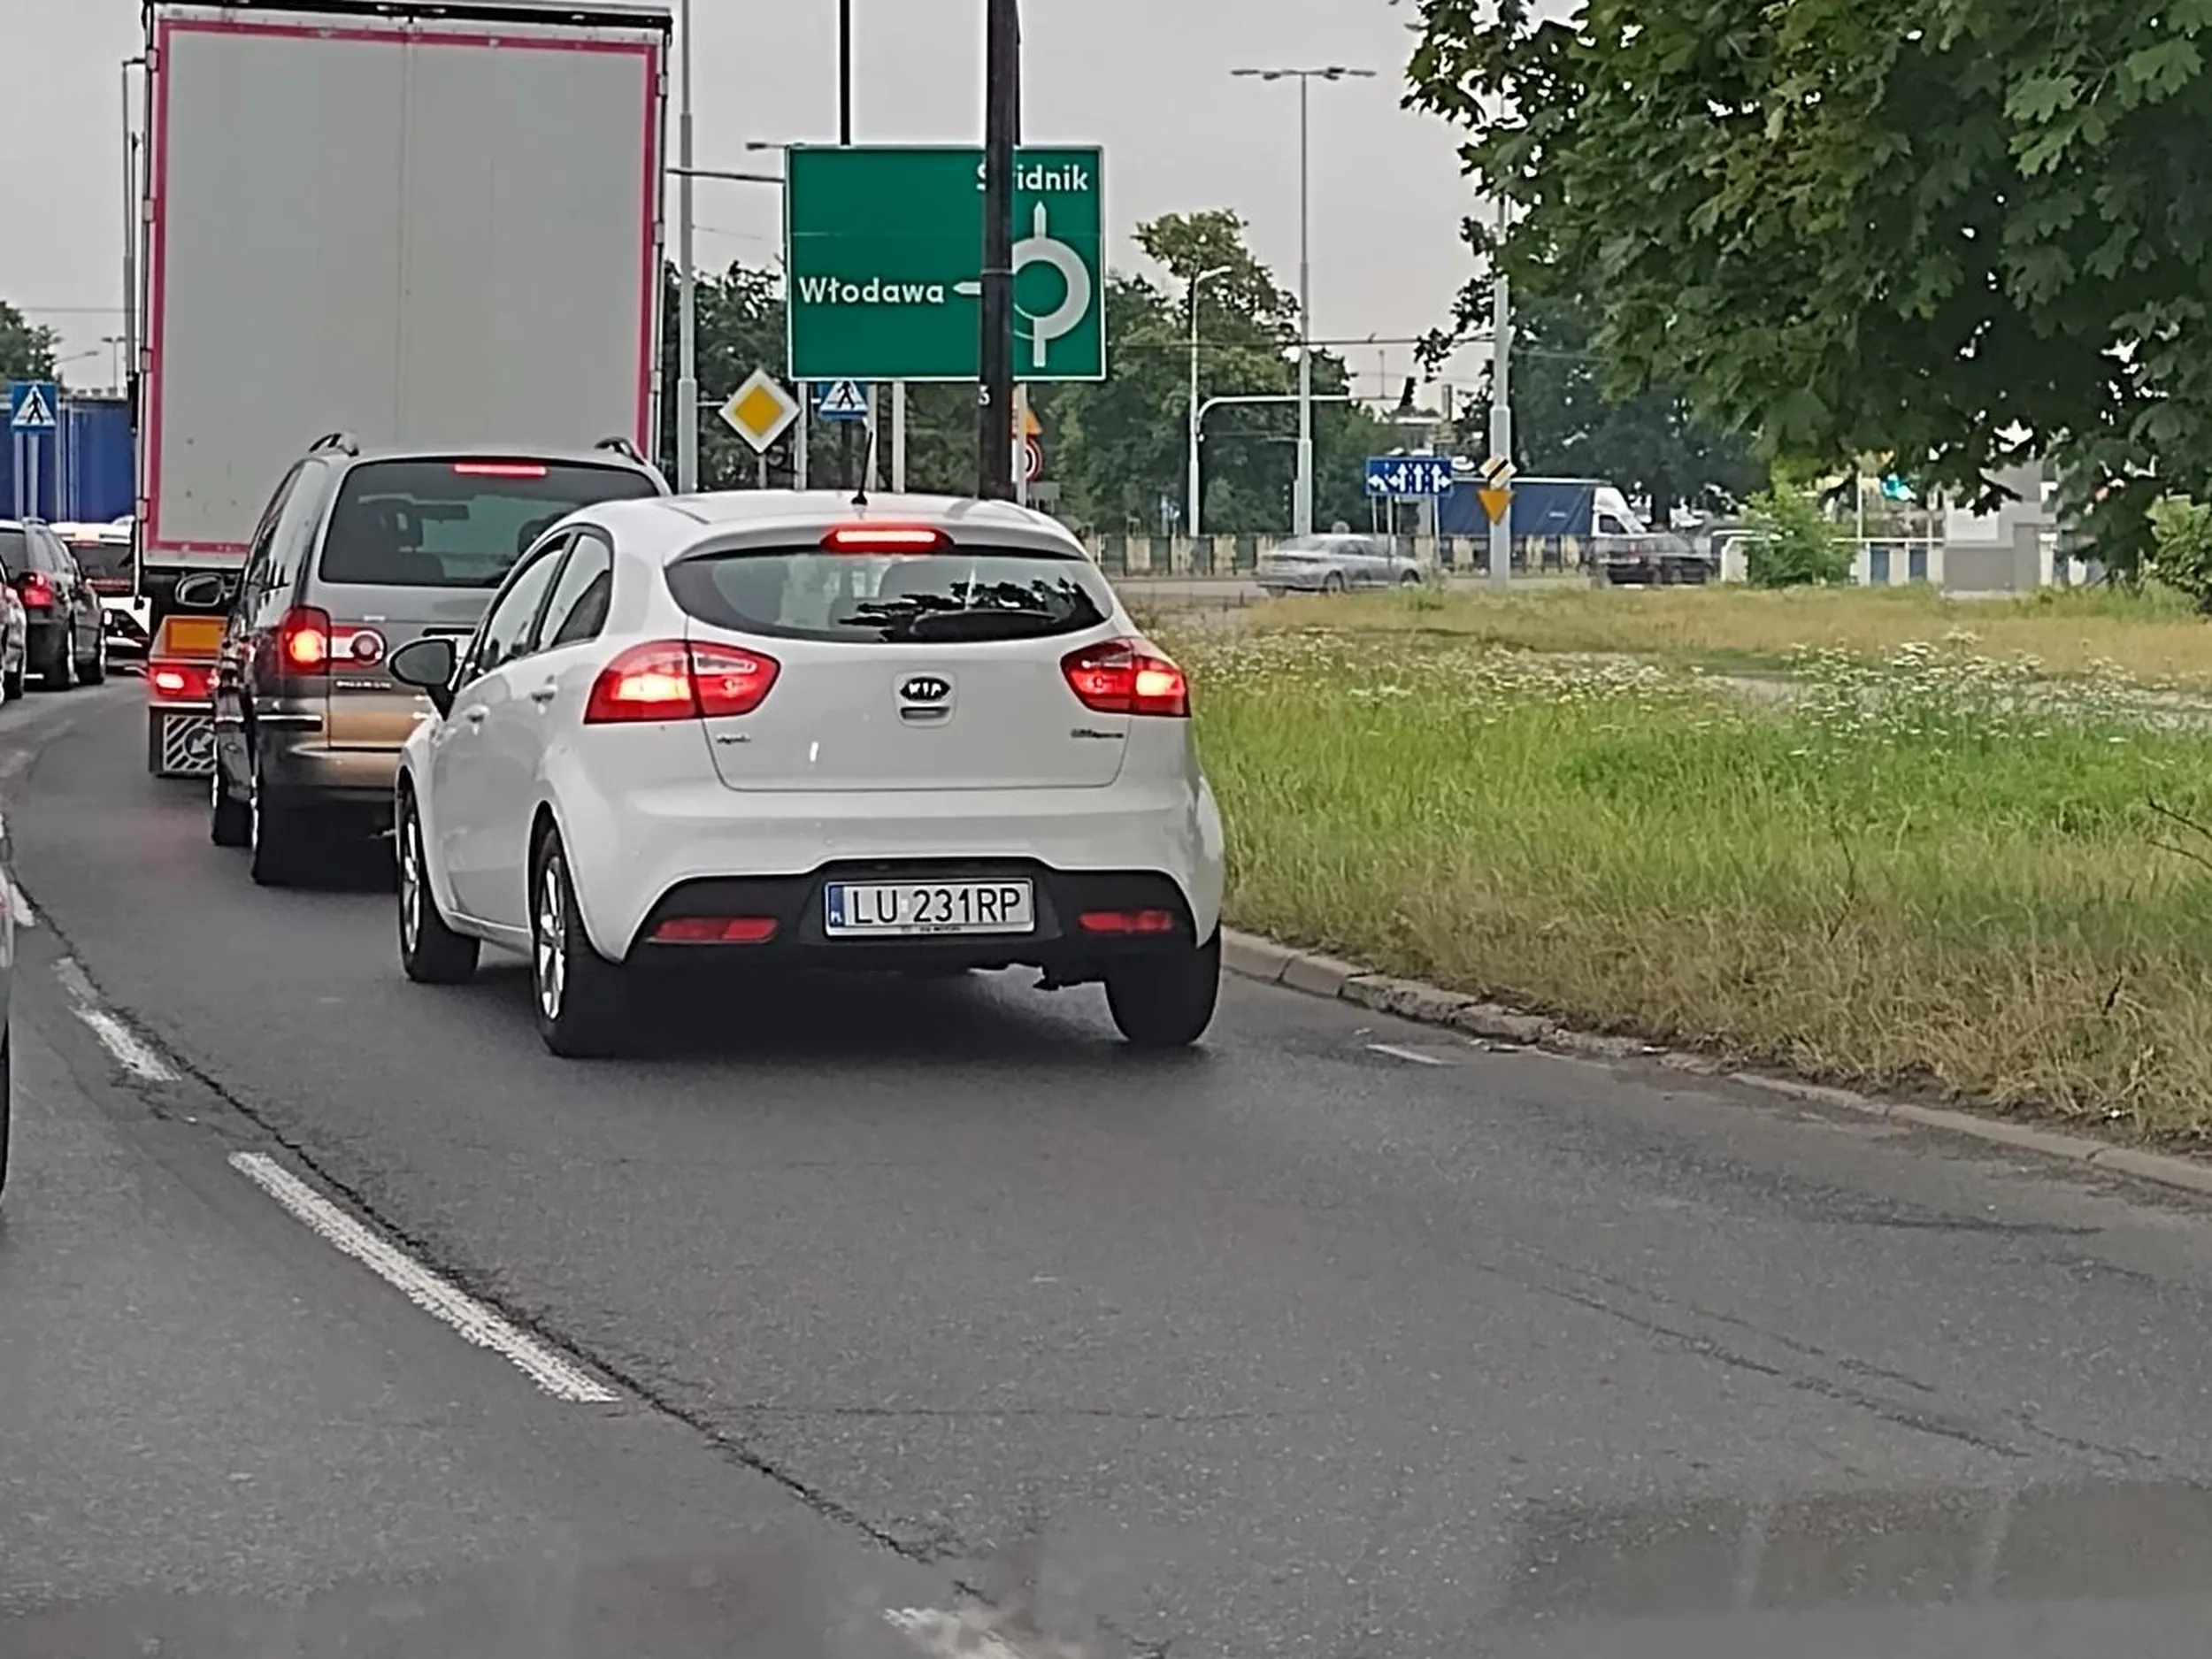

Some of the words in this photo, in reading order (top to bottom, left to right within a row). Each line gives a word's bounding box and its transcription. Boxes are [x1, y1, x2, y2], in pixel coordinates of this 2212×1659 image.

[798, 276, 945, 303] Włodawa
[852, 889, 898, 924] LU
[912, 887, 1020, 923] 231RP
